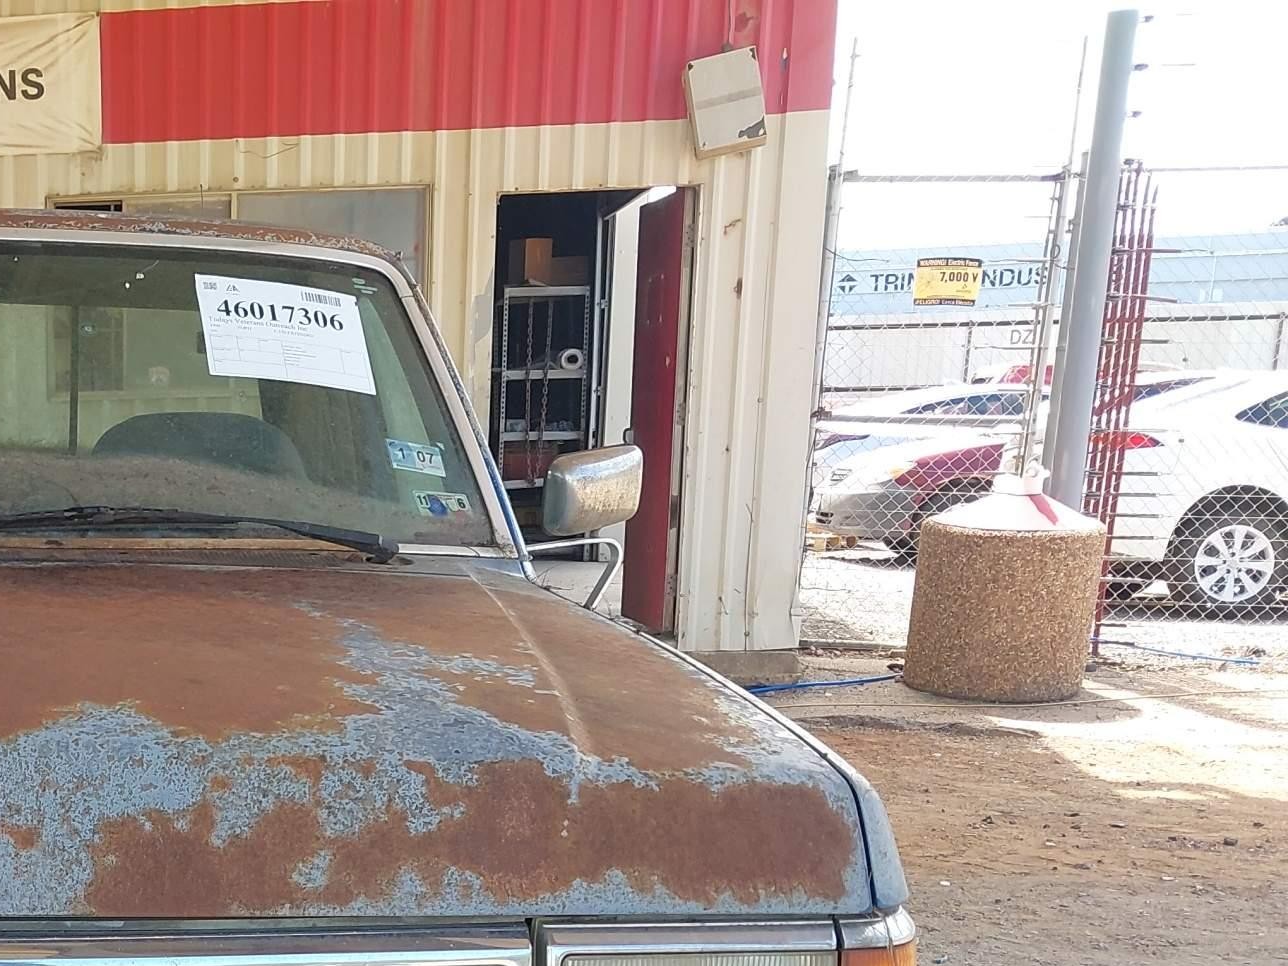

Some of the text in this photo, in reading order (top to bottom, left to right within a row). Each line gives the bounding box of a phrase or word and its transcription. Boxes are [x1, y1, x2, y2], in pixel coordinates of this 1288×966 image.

[939, 271, 979, 283] 7,000 V
[216, 298, 345, 332] 46017306
[416, 450, 434, 465] 07
